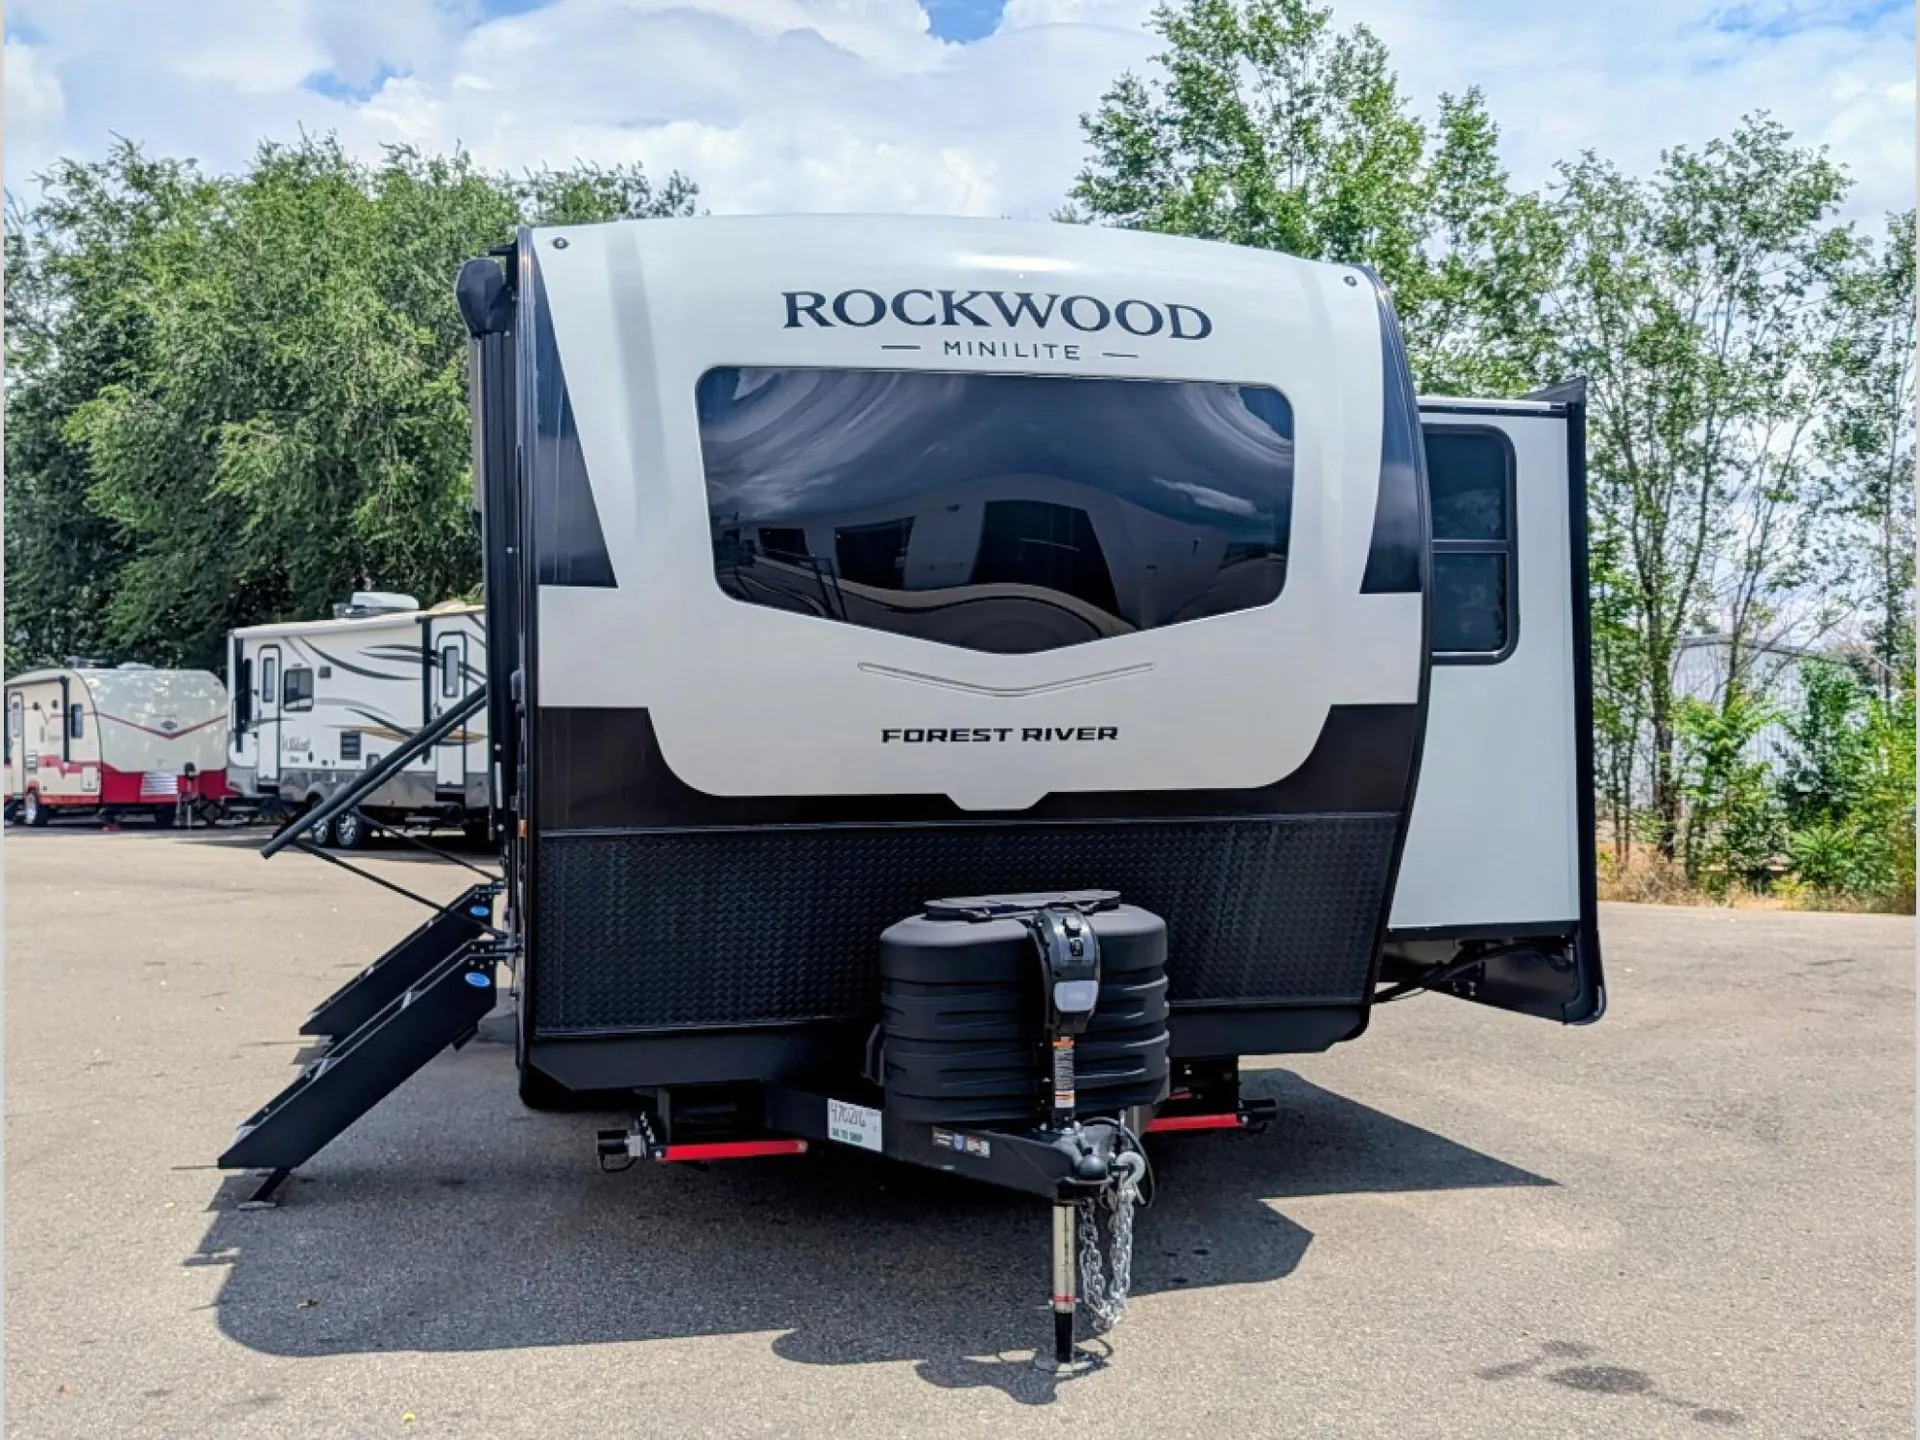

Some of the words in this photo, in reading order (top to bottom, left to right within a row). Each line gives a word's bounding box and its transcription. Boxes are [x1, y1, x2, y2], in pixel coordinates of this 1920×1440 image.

[781, 289, 1213, 340] ROCKWOOD
[943, 340, 1081, 360] MINILITE
[881, 728, 1014, 743] FOREST
[1021, 726, 1118, 742] RIVER
